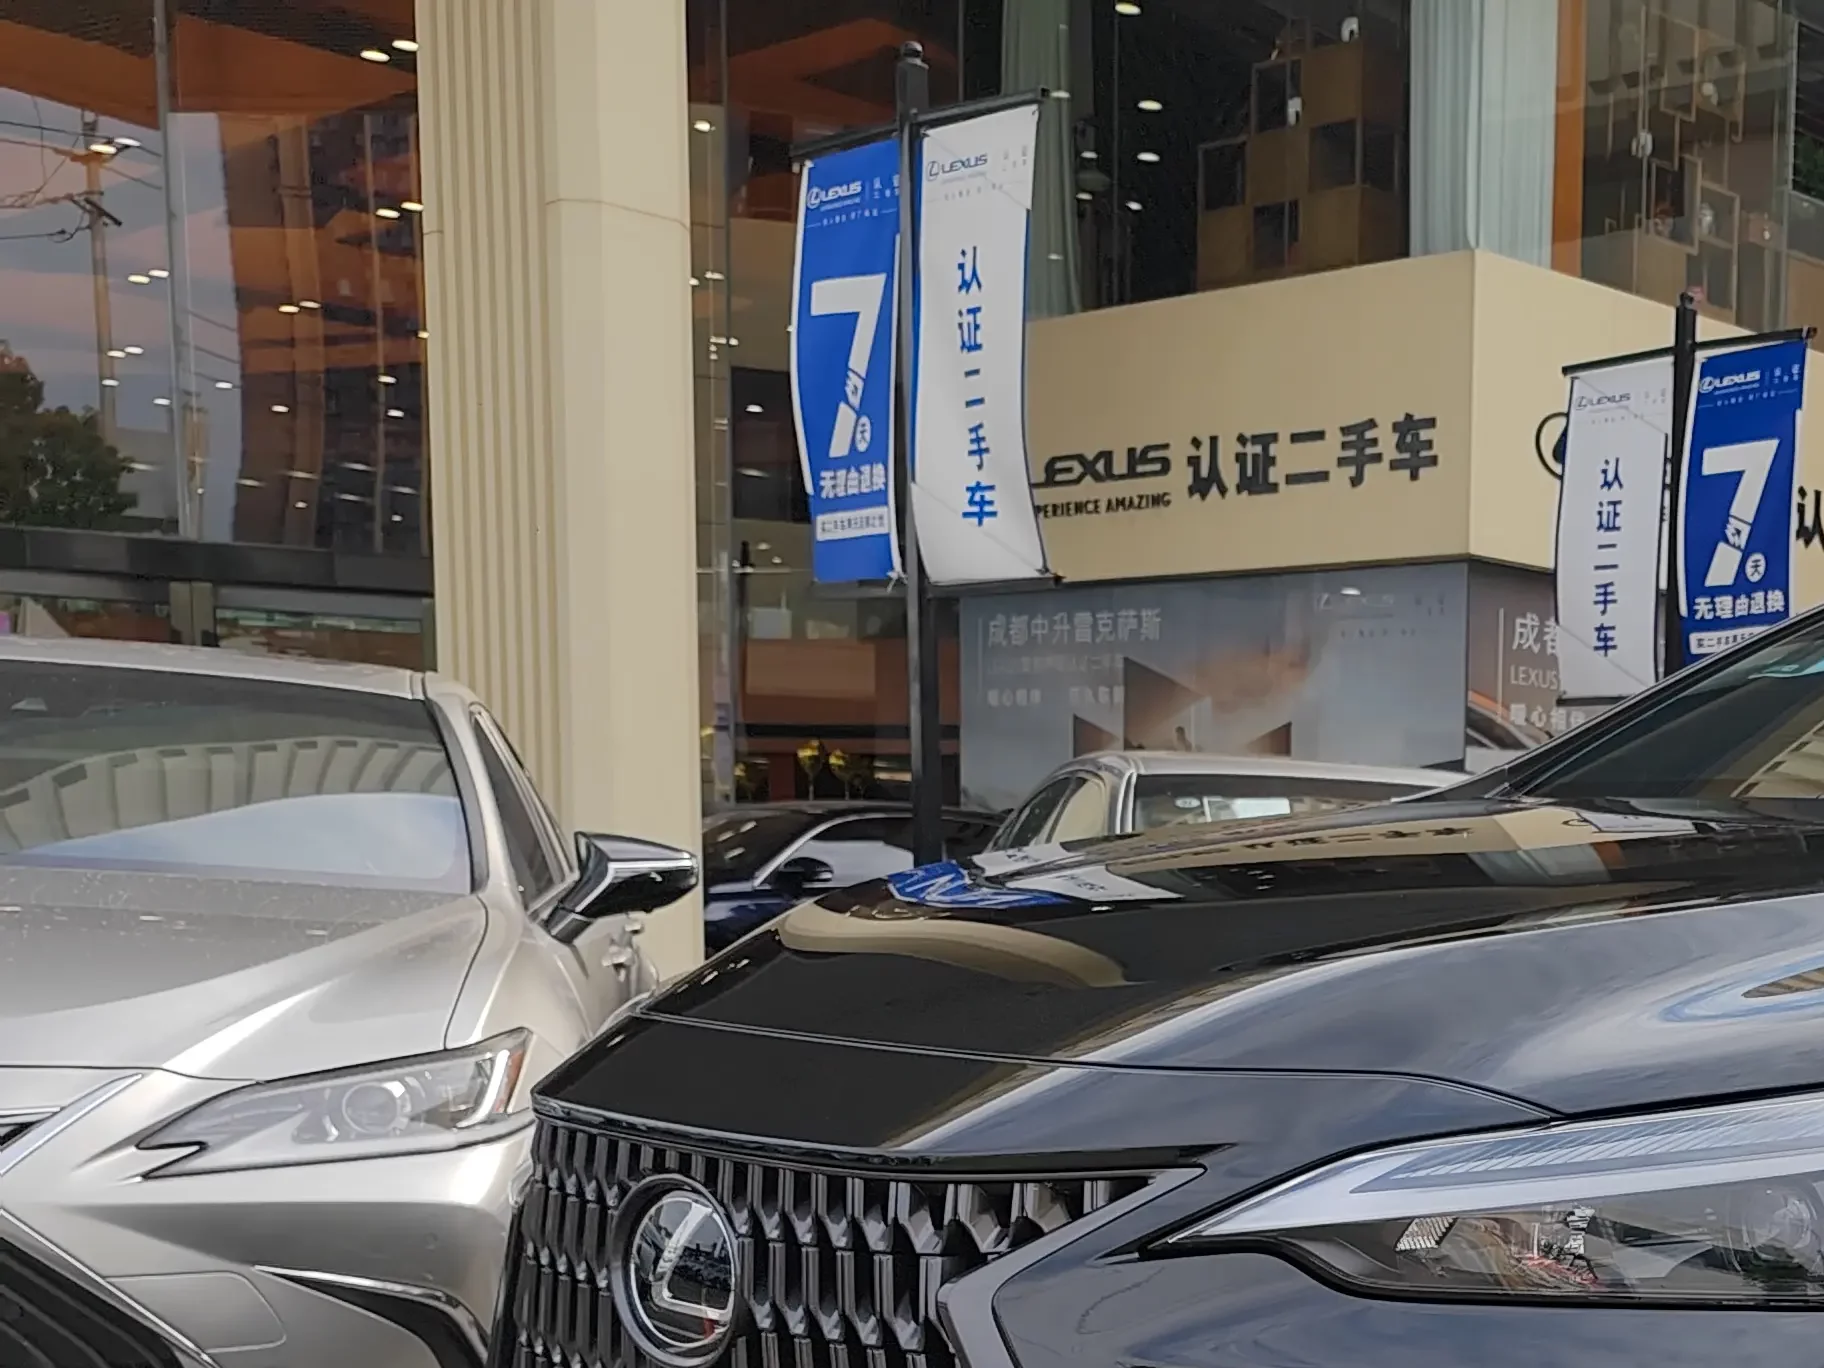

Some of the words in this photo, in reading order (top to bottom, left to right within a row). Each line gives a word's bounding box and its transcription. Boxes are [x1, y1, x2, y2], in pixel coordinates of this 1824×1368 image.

[820, 181, 863, 202] LEXUS
[941, 153, 988, 174] LEXUS
[810, 272, 887, 458] 7
[957, 246, 998, 527] 认证二手车
[1187, 412, 1439, 502] 认证二手车
[1105, 491, 1172, 513] AMAZING
[1702, 438, 1780, 588] 7
[1593, 457, 1624, 657] 认证二手车
[986, 608, 1163, 647] 成都中升雷克萨斯
[1693, 588, 1786, 621] 无理由退换
